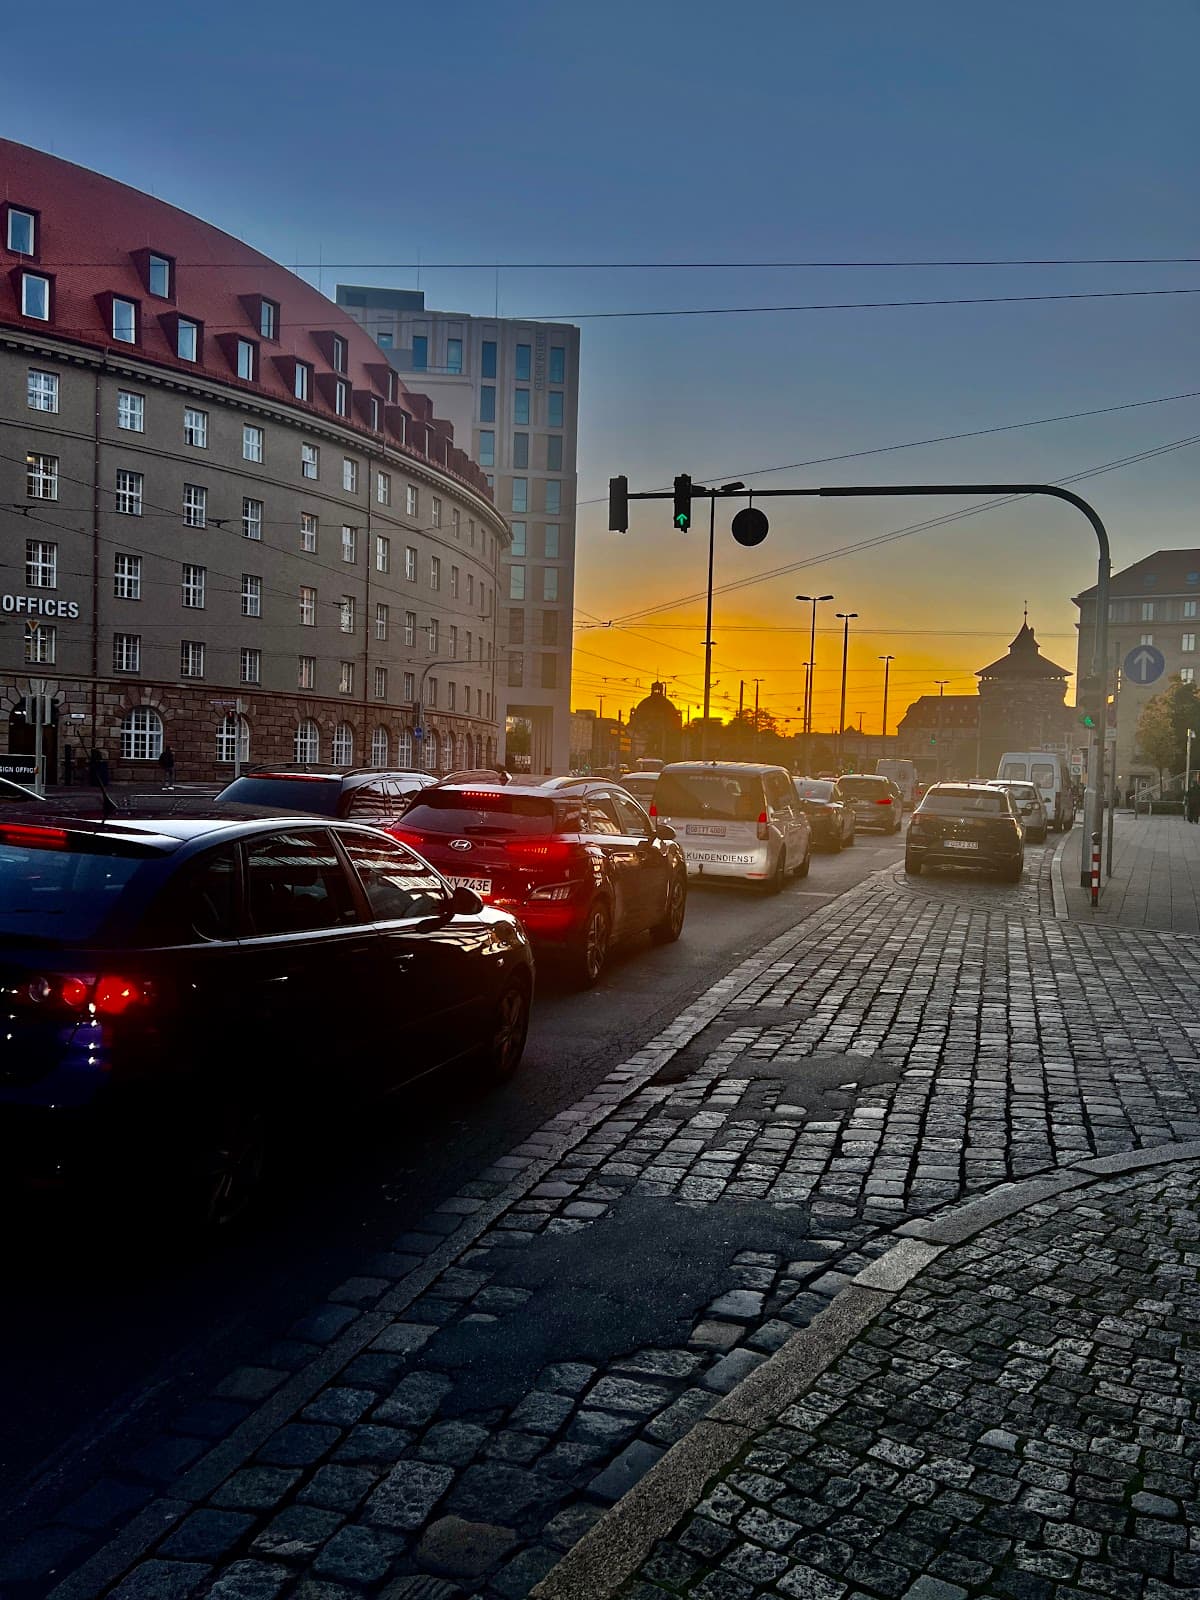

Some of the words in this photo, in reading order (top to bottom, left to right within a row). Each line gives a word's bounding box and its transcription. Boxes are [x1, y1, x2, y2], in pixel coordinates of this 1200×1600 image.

[2, 594, 79, 618] OFFICES
[15, 766, 34, 774] OFFIC
[686, 852, 754, 863] KUNDENDIENST
